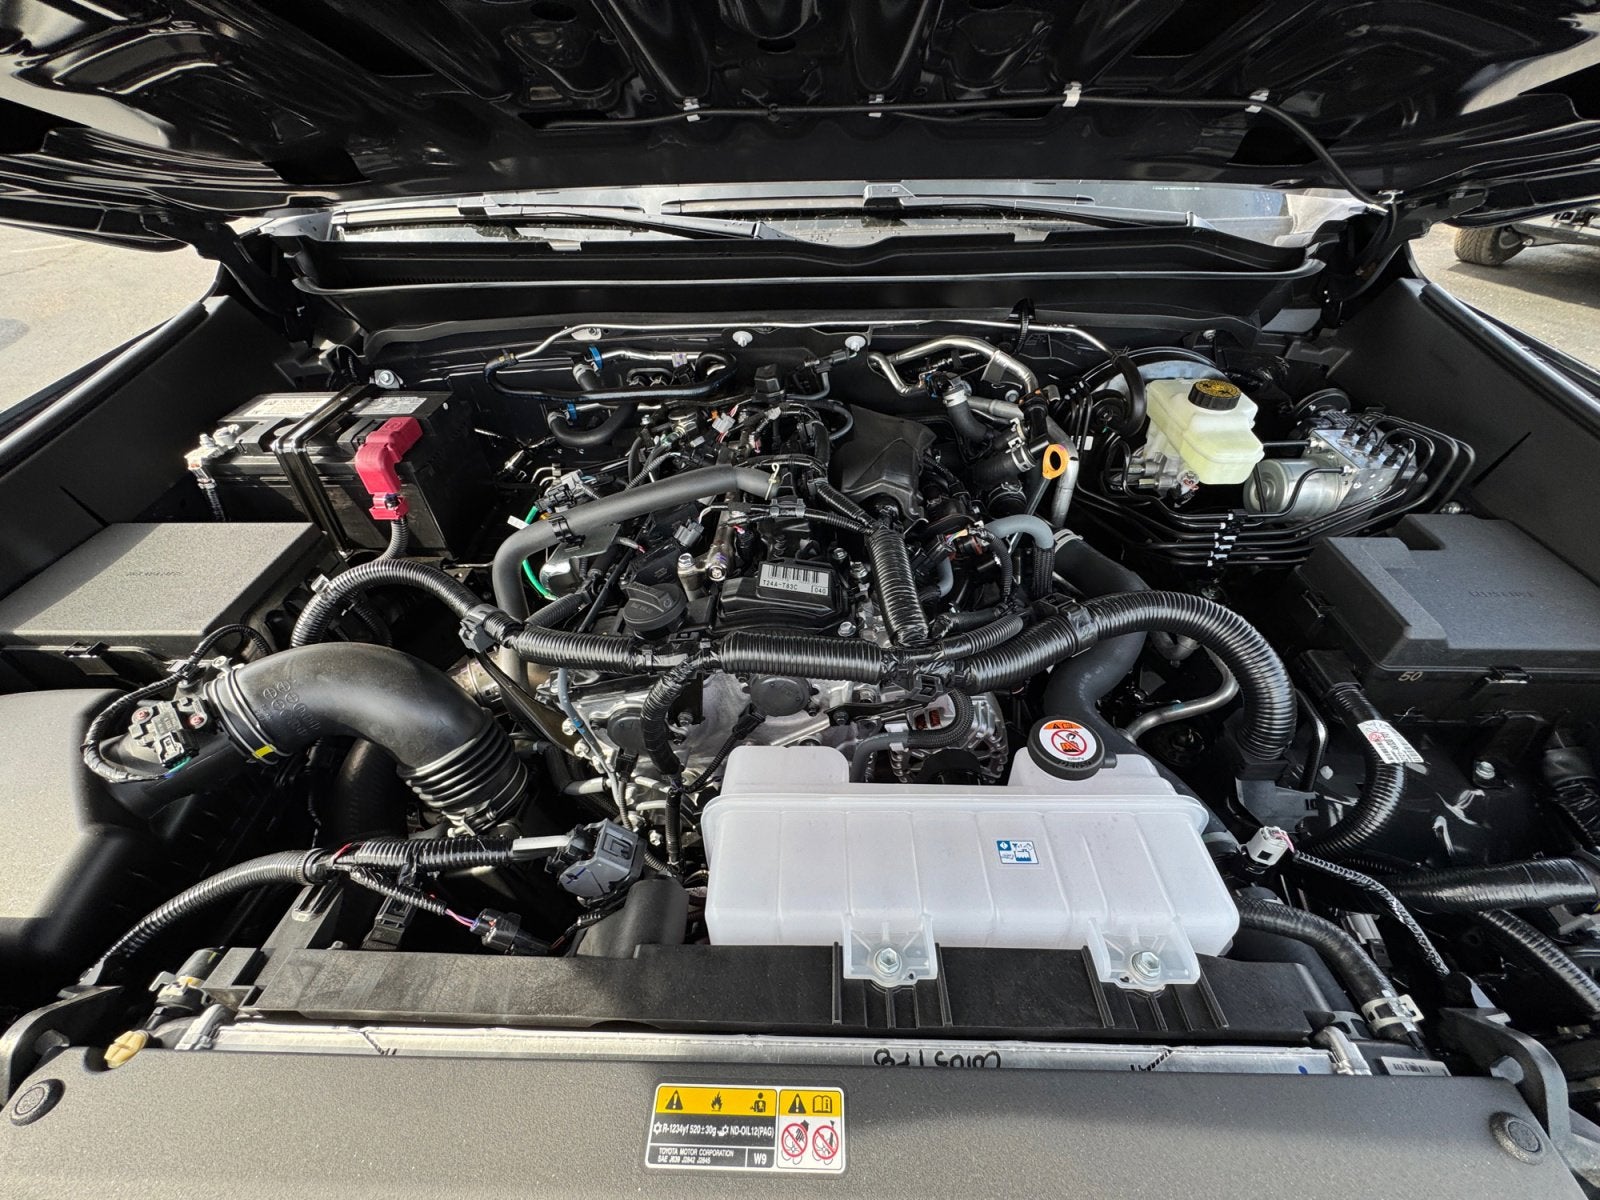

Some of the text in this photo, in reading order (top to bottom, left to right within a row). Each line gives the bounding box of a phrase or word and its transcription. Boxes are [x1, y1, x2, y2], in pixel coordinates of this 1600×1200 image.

[1398, 671, 1424, 681] 50
[662, 1123, 689, 1136] R-1234yf
[730, 1125, 775, 1139] ND-OIL12(PAG)
[659, 1147, 734, 1157] TOYOTA MOTOR CORPORATION
[657, 1155, 668, 1163] SAE
[753, 1153, 767, 1165] W9
